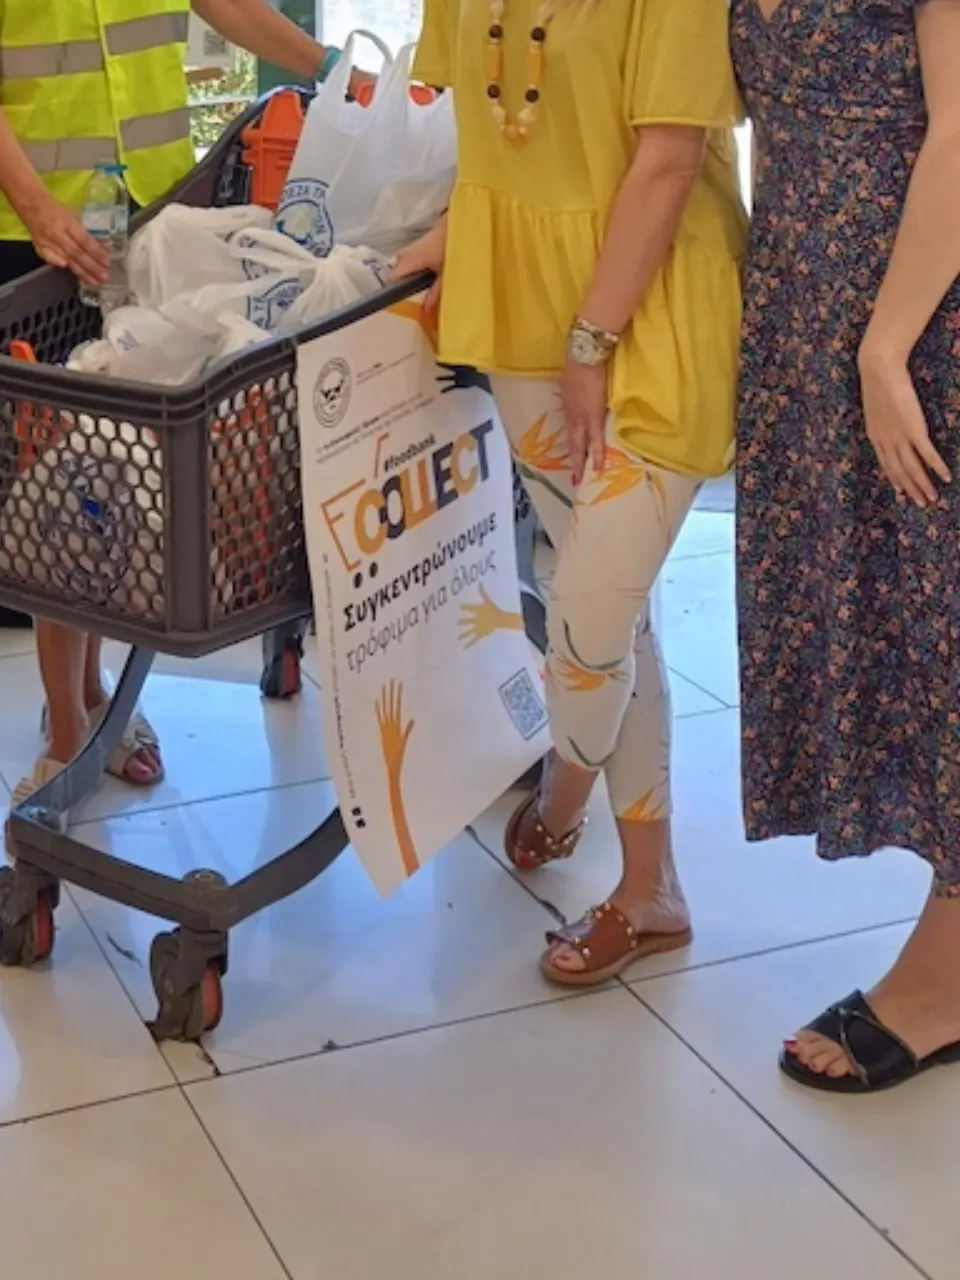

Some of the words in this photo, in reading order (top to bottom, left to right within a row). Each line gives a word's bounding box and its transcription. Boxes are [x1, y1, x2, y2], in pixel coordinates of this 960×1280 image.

[354, 418, 495, 556] COLLECT
[343, 511, 498, 633] Συγκεντρώνουμε
[345, 604, 420, 674] τρόφιμα
[421, 586, 448, 620] για
[450, 550, 498, 598] όλους
